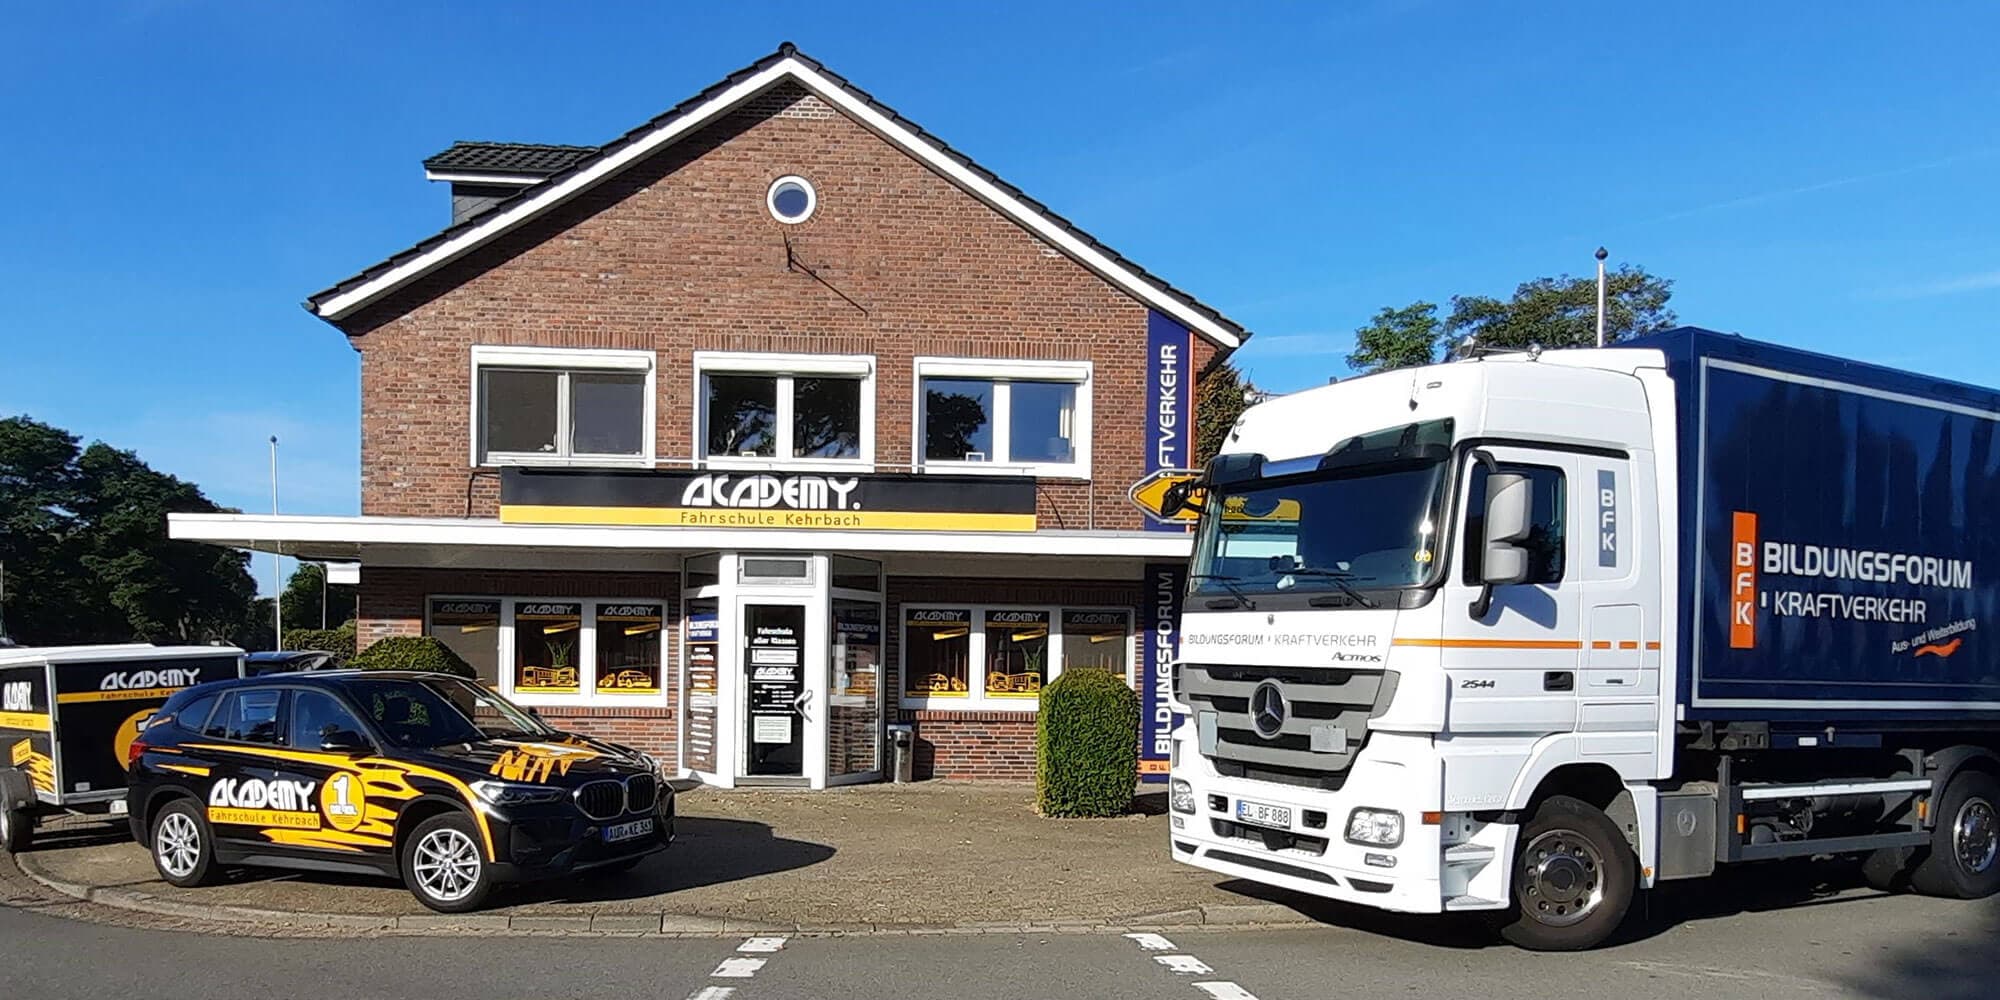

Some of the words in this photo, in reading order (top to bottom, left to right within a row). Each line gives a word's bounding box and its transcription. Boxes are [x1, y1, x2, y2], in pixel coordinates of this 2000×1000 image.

[1159, 344, 1177, 477] FTVERKEHR
[681, 474, 862, 510] ACADEMY.
[681, 512, 775, 525] Fahrschule
[786, 513, 861, 526] Kehrbach
[1601, 488, 1615, 551] BFK
[1763, 541, 1972, 589] BILDUNGSFORUM
[1736, 542, 1753, 625] BFK
[1774, 591, 1927, 623] KRAFTVERKEHR
[1188, 633, 1264, 645] BILDUNGSFORUM
[1274, 634, 1376, 647] KRAFTVERKEHR
[1911, 632, 1927, 647] und
[1927, 618, 1976, 641] Weiterbildung
[1155, 572, 1173, 755] BILDUNGSFORUM
[101, 690, 154, 700] Fahrschule
[1461, 679, 1495, 689] 2544
[209, 777, 317, 812] ACADEMY.
[210, 810, 266, 823] Fahrschule
[272, 813, 319, 827] Kehrbach
[1241, 803, 1253, 818] EL
[1258, 806, 1270, 820] BF
[1272, 808, 1289, 824] 888
